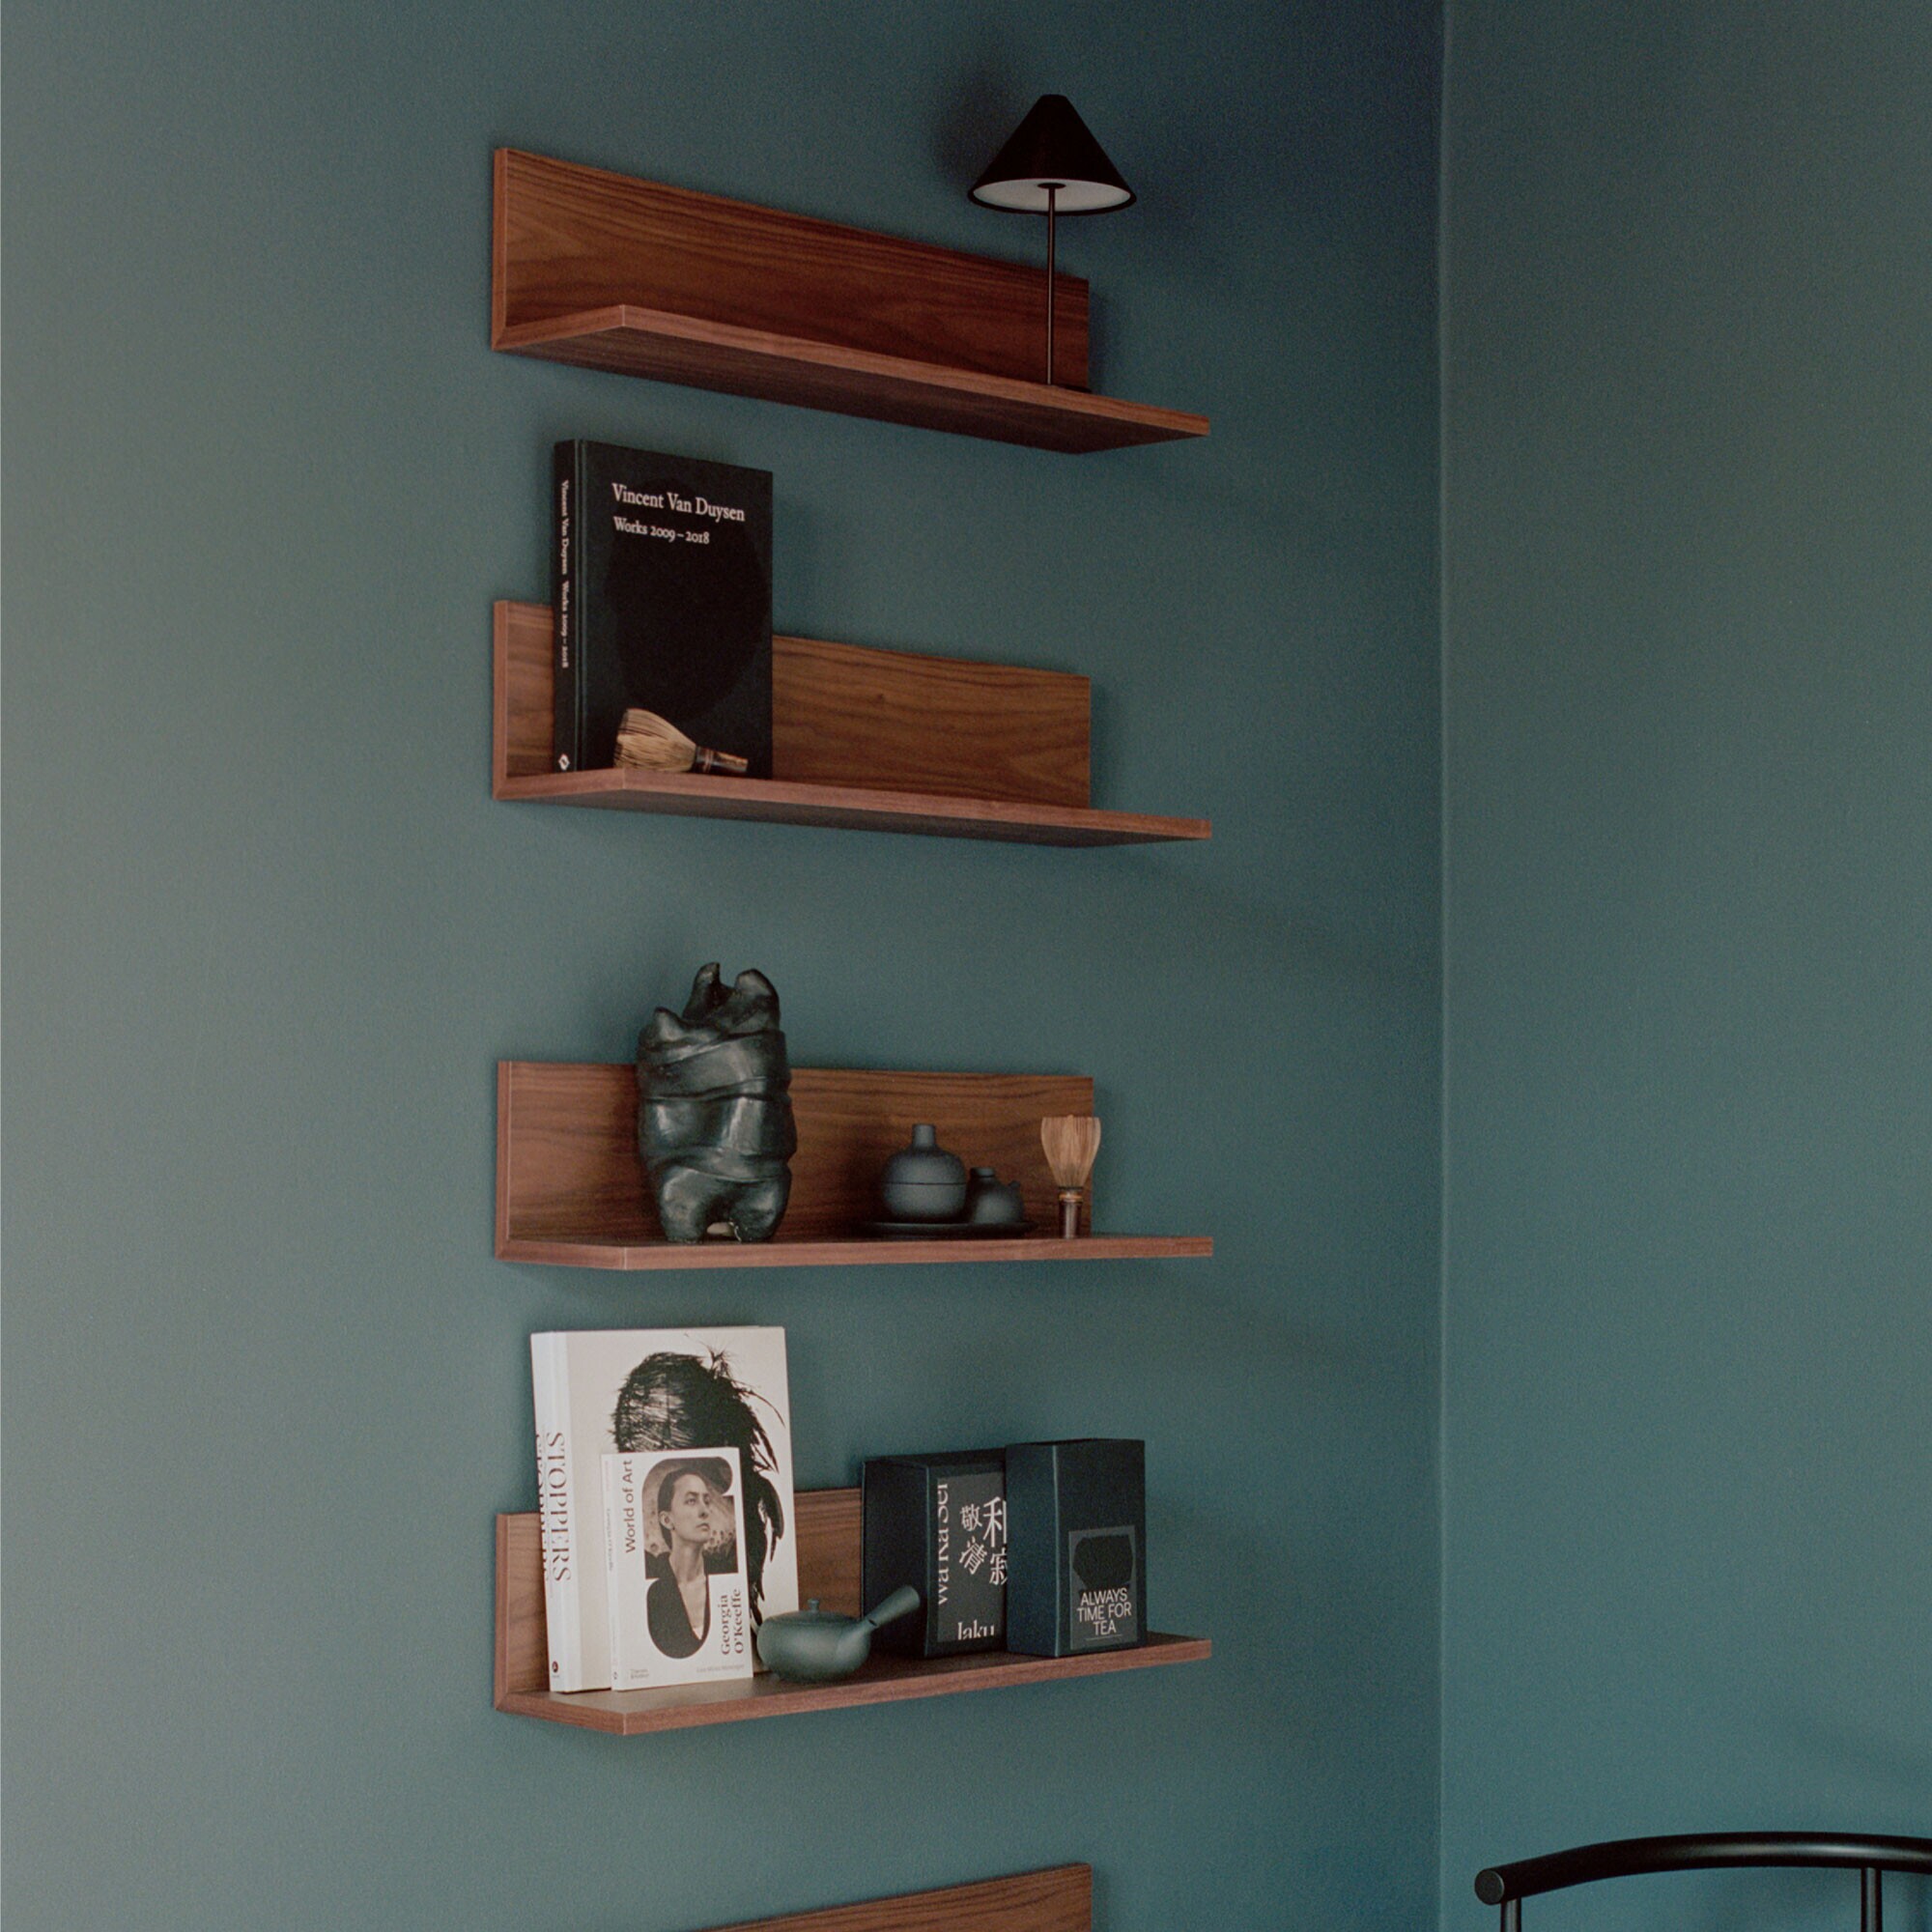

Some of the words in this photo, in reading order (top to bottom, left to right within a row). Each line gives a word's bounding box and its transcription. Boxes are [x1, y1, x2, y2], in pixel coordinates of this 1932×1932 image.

[560, 480, 569, 517] Vincent
[611, 483, 664, 509] Vincent
[667, 492, 692, 513] Van
[695, 497, 746, 523] Duysen
[560, 519, 569, 536] Van
[613, 516, 648, 535] Works
[650, 526, 675, 543] 2009
[686, 531, 710, 545] 2018
[560, 537, 569, 575] Duysen
[623, 1460, 634, 1484] Art
[547, 1432, 572, 1581] STOPPERS
[622, 1488, 634, 1503] of
[626, 1508, 636, 1553] World
[1081, 1588, 1128, 1605] ALWAYS
[719, 1595, 730, 1655] Georgia
[1076, 1605, 1106, 1623] TIME
[1108, 1602, 1132, 1619] FOR
[1094, 1620, 1117, 1635] TEA
